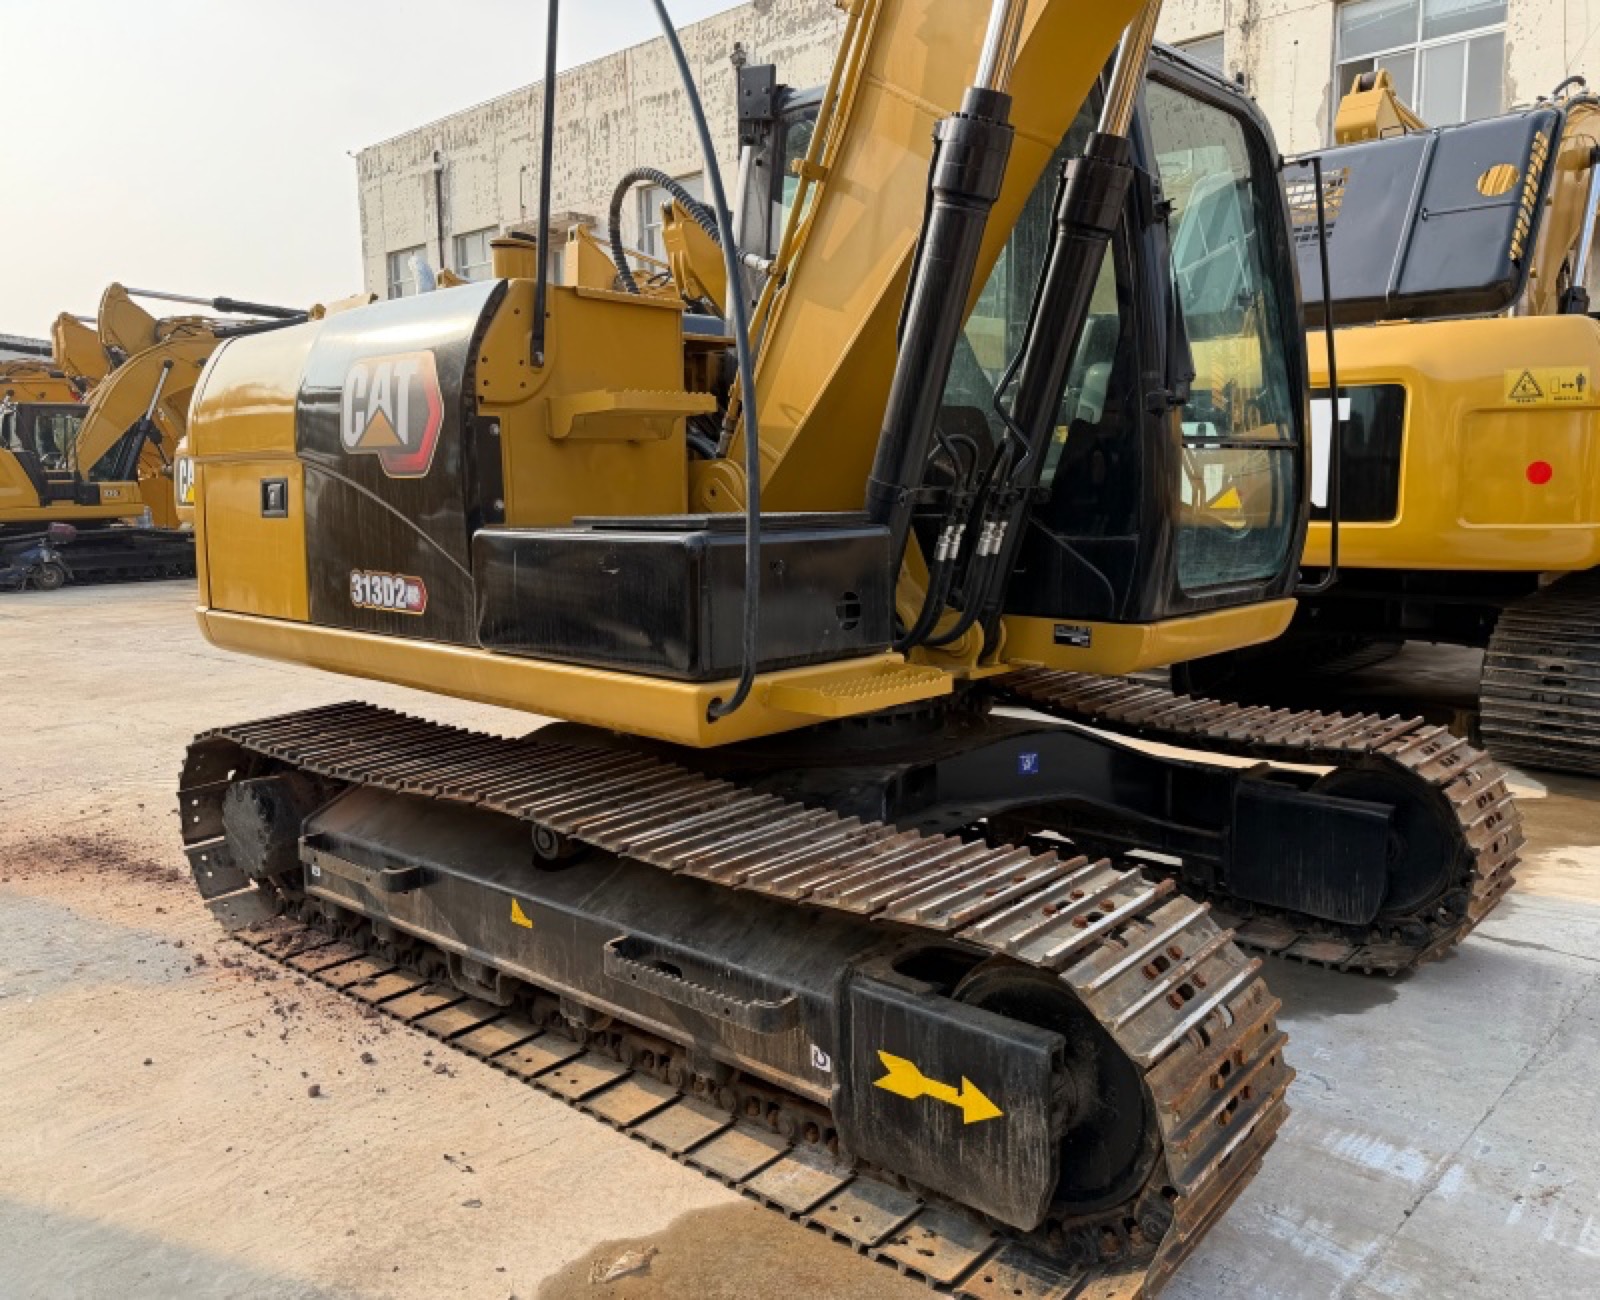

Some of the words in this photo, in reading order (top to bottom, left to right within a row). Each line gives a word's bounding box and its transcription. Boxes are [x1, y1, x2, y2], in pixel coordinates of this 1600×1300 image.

[343, 360, 418, 447] CAT
[179, 459, 194, 503] CA
[351, 573, 406, 609] 313D2
